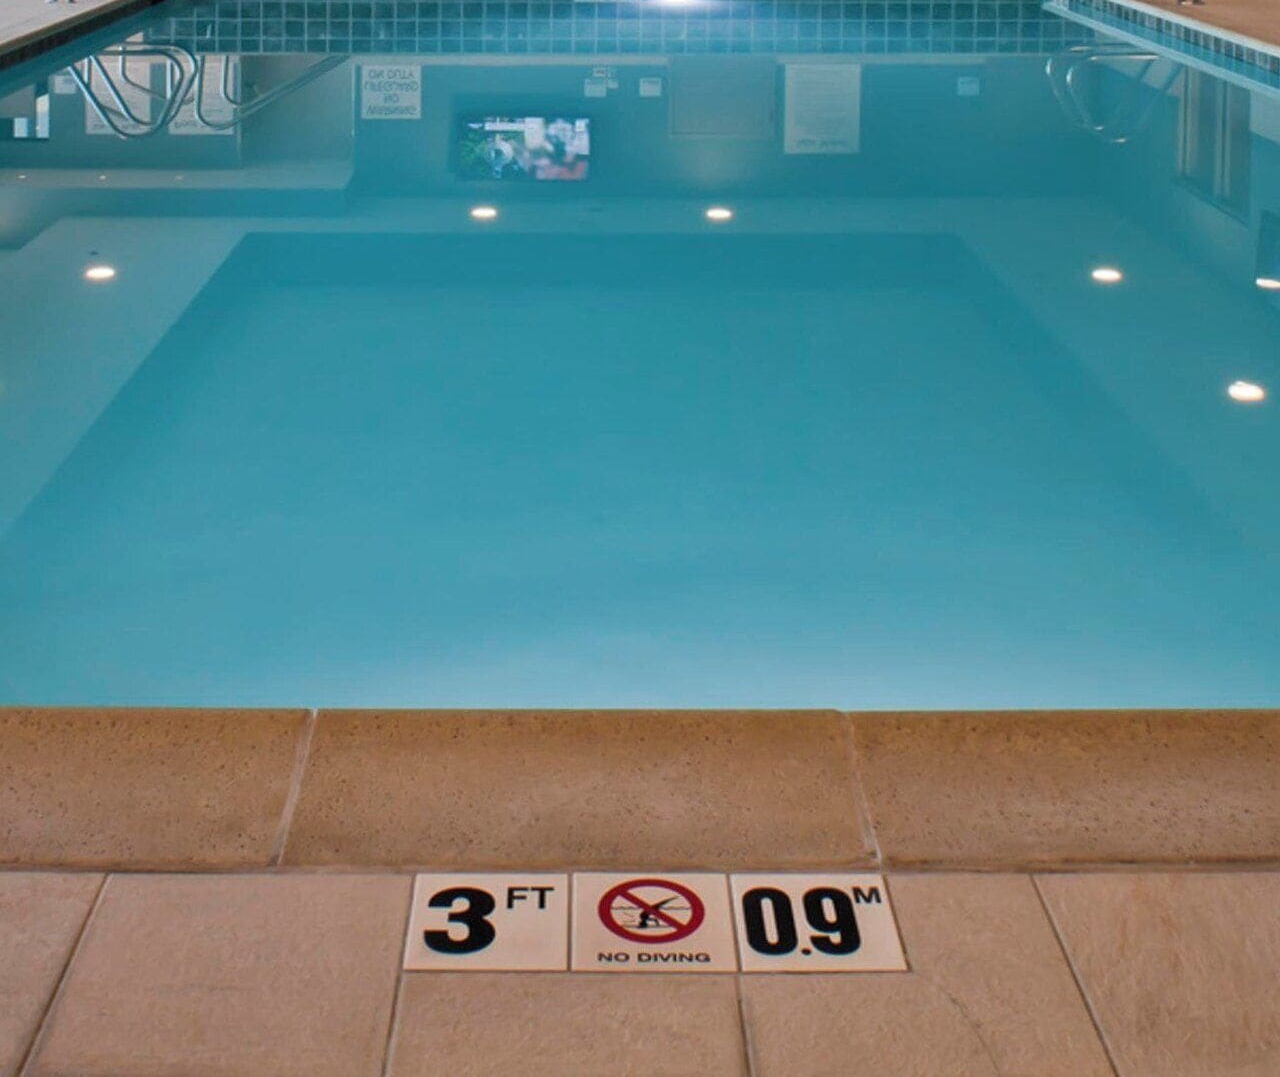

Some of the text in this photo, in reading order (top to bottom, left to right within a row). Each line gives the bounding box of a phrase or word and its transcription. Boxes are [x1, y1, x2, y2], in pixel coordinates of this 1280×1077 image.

[424, 887, 882, 955] 3 FT 0.9 M
[598, 952, 711, 962] NO DIVING
